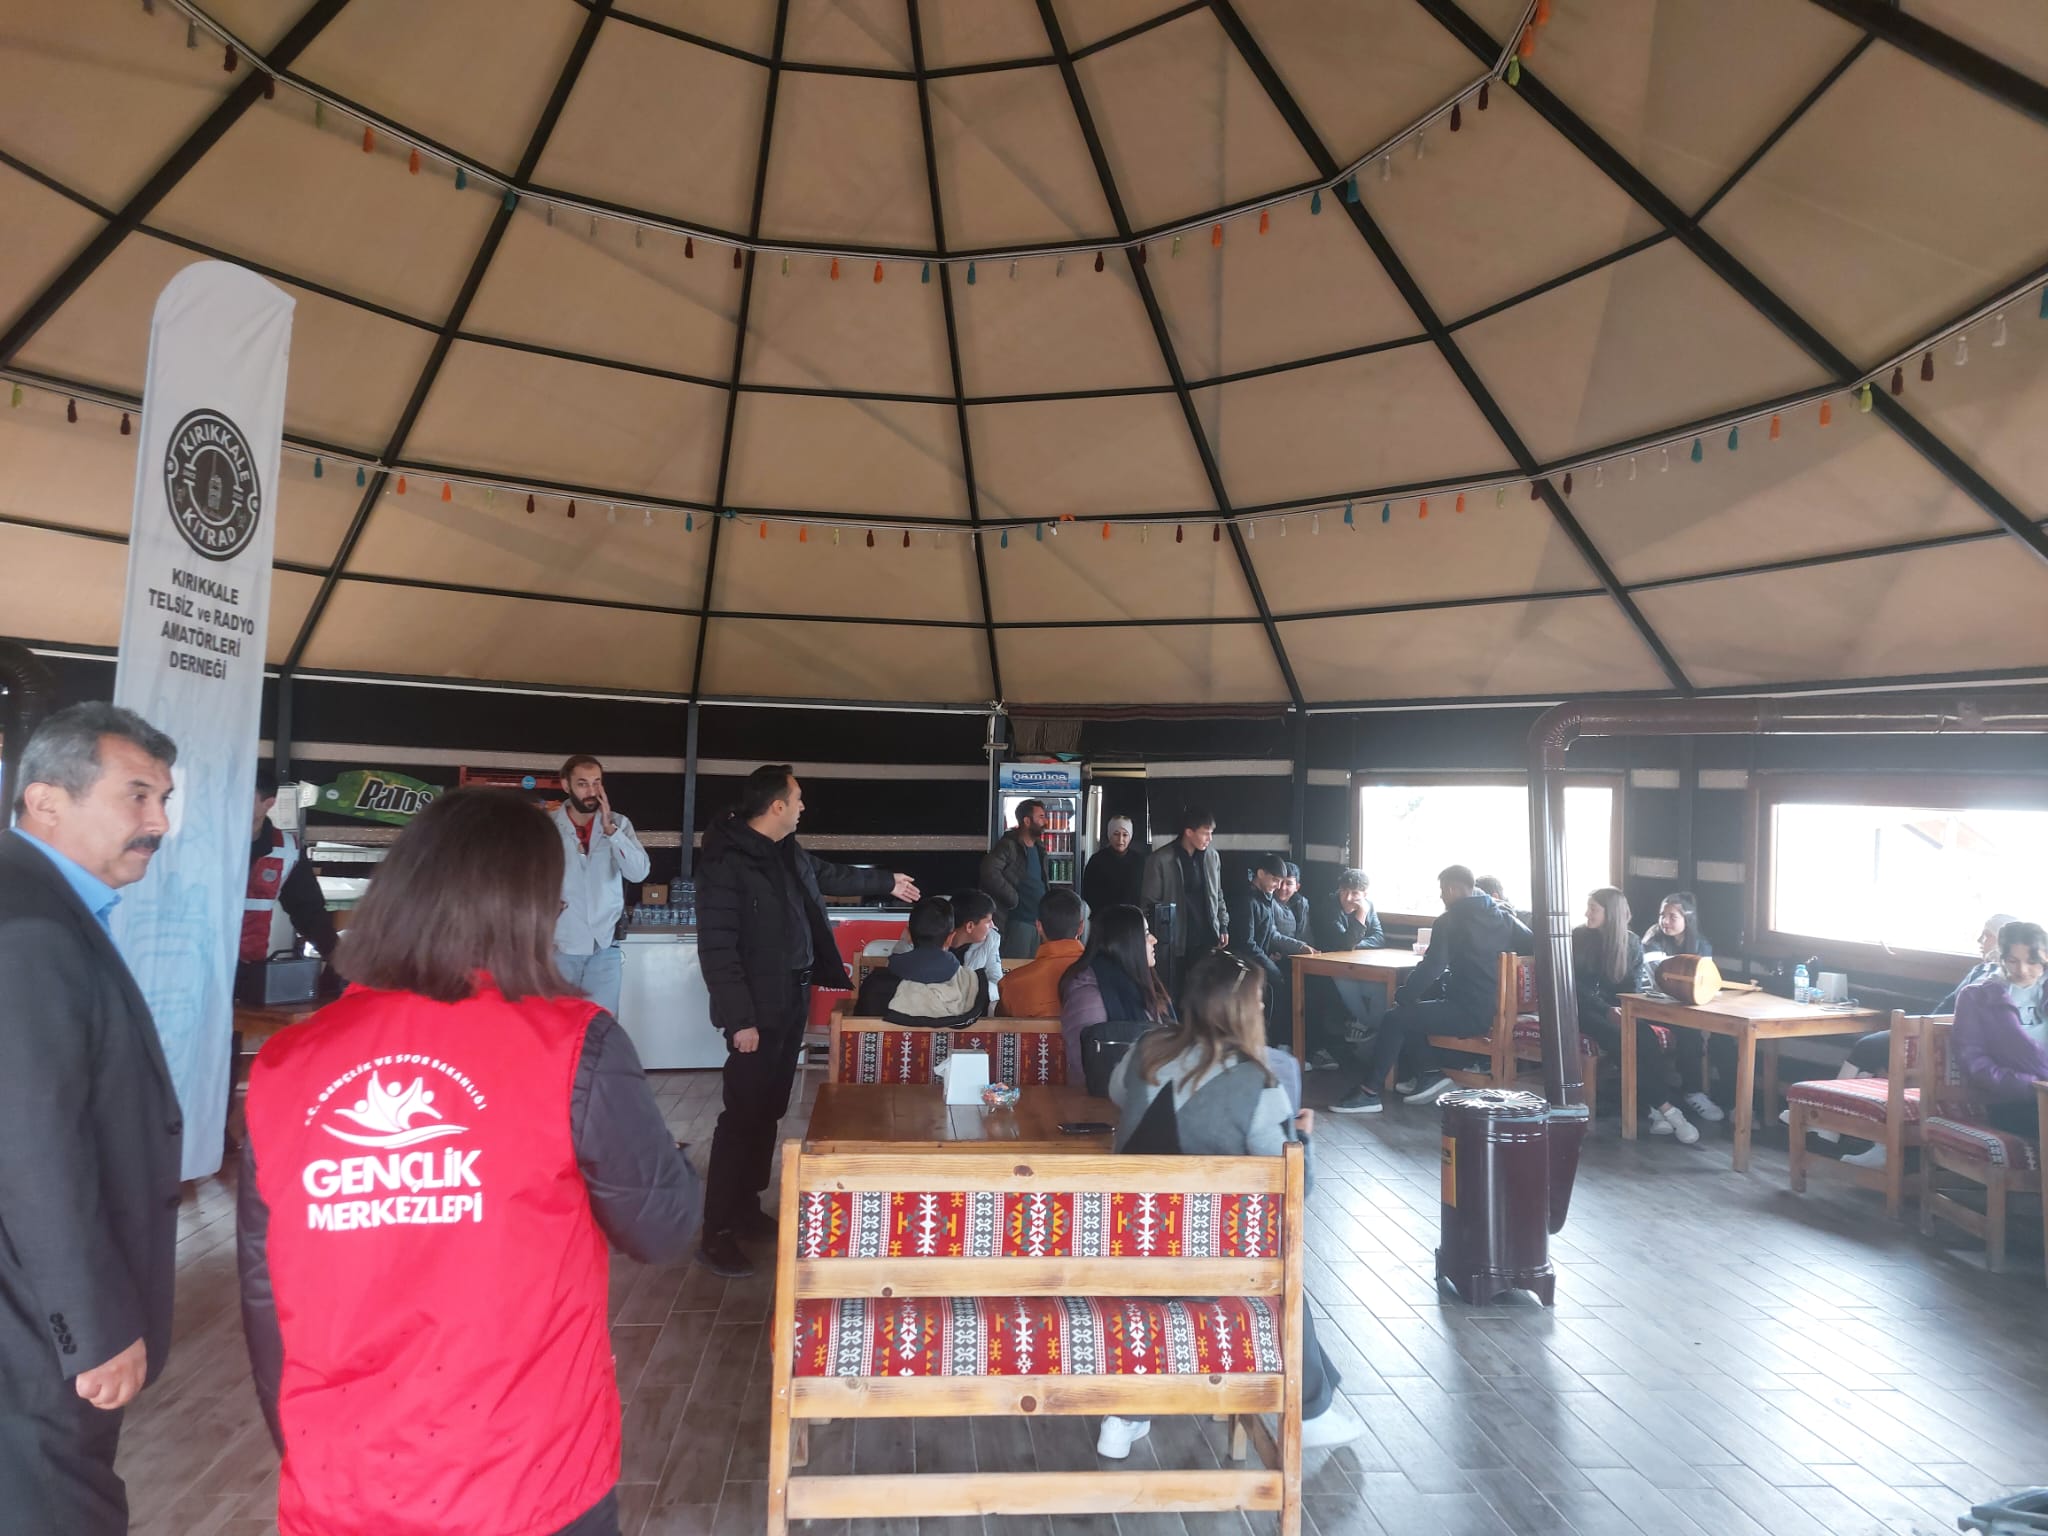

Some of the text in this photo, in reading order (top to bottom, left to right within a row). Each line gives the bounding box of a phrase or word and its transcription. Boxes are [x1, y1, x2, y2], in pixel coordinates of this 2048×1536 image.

[180, 424, 250, 482] KIRIKKALE
[182, 508, 237, 547] KITRAD
[172, 568, 239, 605] KIRIKKALE
[149, 587, 255, 636] TELSİZ ve RADYO
[161, 620, 241, 658] AMATÖRLERİ
[169, 651, 227, 680] DERNEĞİ
[396, 1053, 430, 1066] SPOR
[302, 1147, 482, 1198] GENÇLİK
